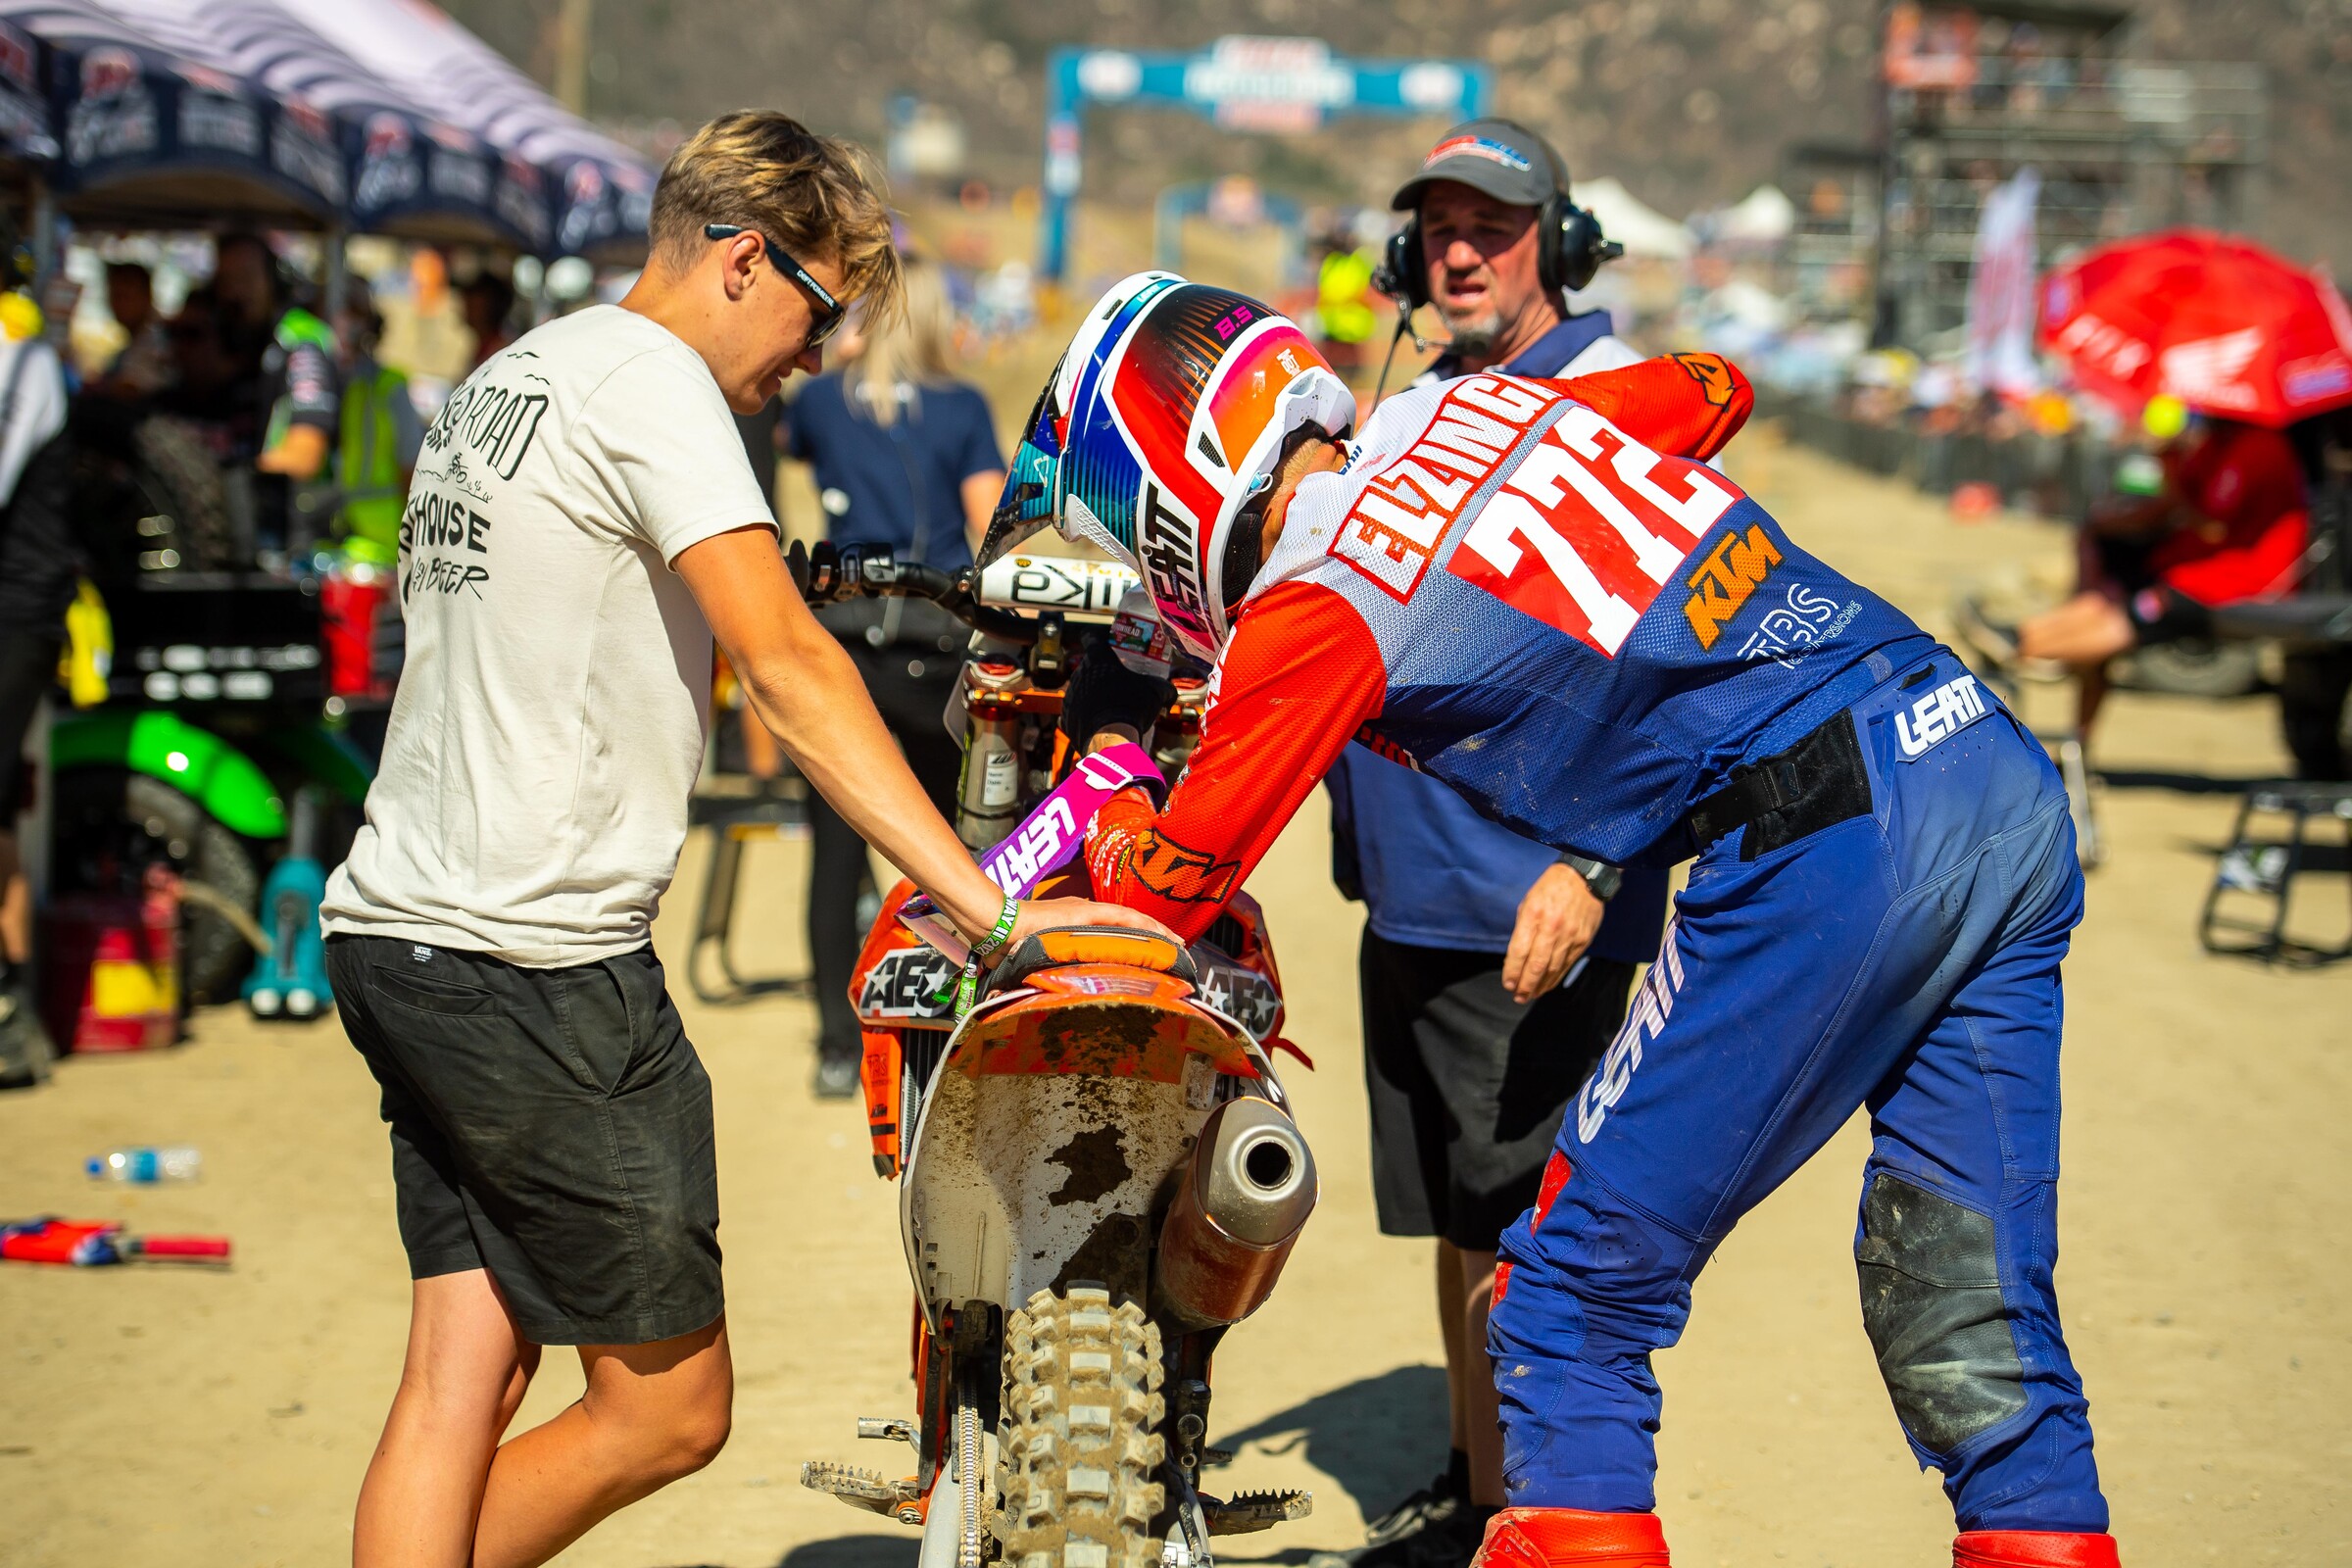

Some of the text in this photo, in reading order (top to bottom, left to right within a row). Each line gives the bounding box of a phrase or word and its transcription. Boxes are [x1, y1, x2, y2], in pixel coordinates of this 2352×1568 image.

[1213, 305, 1253, 340] 8.5
[459, 387, 549, 481] ROAD
[1461, 405, 1736, 658] 772
[426, 558, 489, 601] BEER
[1683, 522, 1784, 652] KTM
[1894, 674, 1986, 756] LEATT
